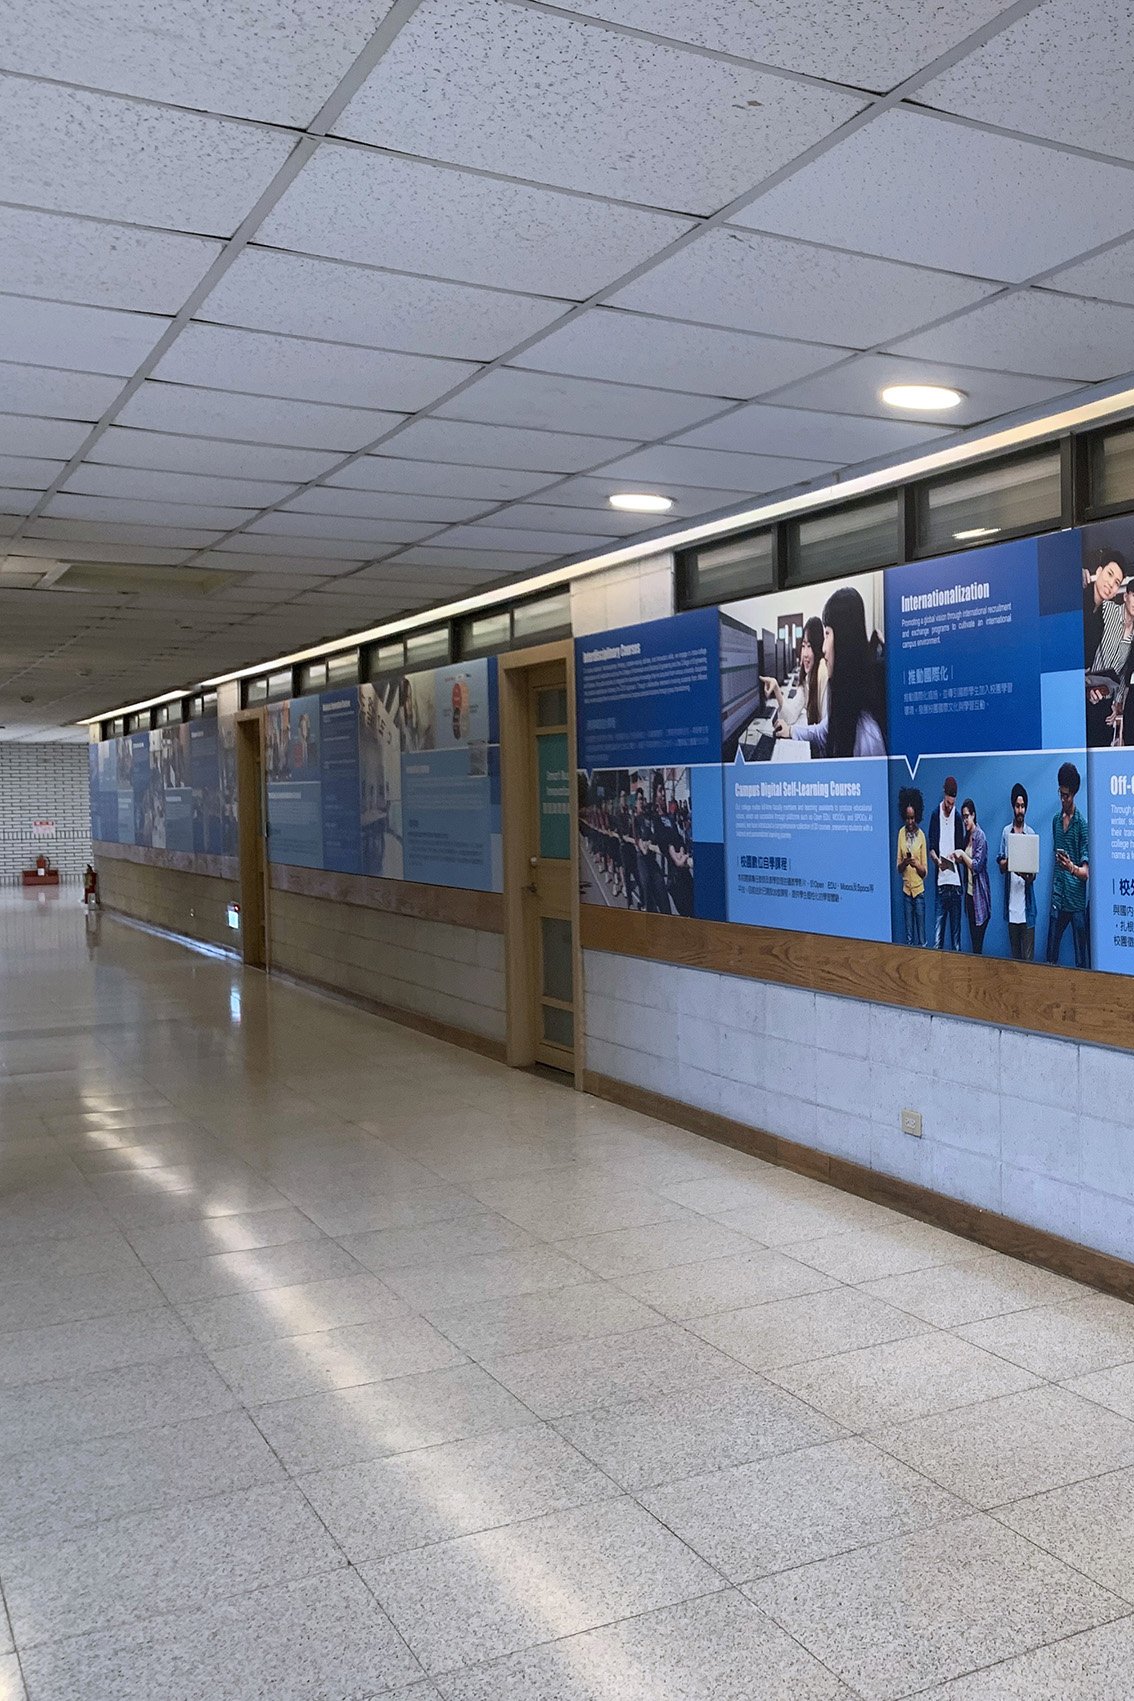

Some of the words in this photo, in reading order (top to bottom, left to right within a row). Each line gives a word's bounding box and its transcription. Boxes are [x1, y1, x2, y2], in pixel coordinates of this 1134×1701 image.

[902, 582, 989, 612] Internationalization
[908, 665, 948, 685] 推動國際化
[735, 782, 760, 798] Campus
[760, 782, 782, 798] Digital
[783, 781, 829, 798] Self-Learning
[830, 781, 861, 797] Courses
[1111, 804, 1132, 816] Through
[1111, 828, 1122, 838] their
[1111, 838, 1130, 850] college
[1112, 852, 1126, 860] name
